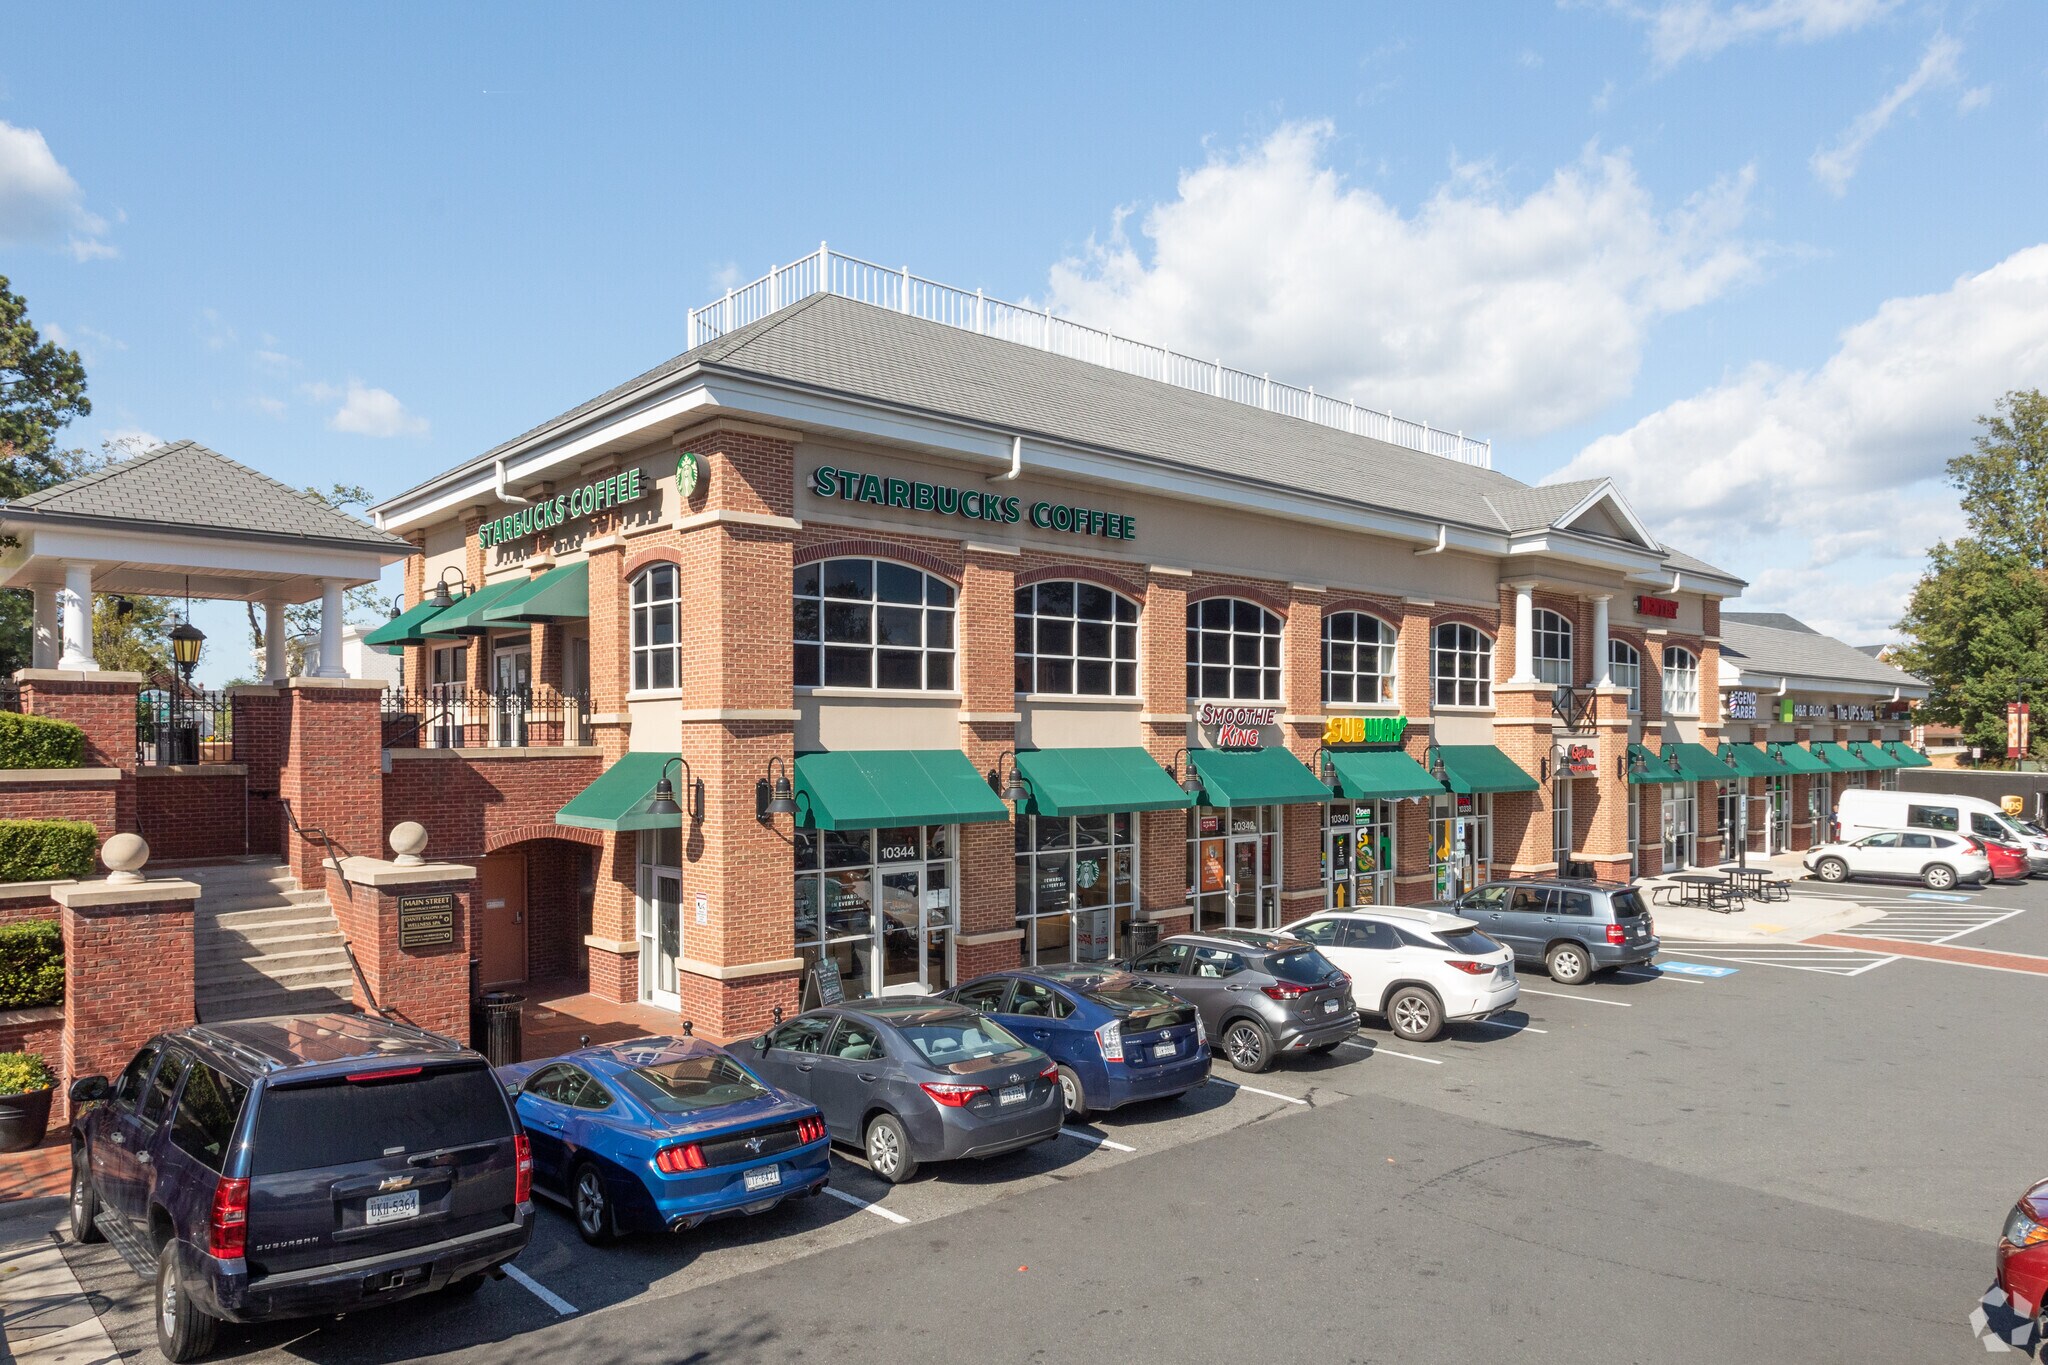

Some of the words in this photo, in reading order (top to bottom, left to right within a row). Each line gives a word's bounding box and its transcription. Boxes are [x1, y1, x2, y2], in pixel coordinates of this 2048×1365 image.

[479, 494, 565, 550] STARBUCKS
[570, 467, 641, 518] COFFEE
[815, 465, 1021, 524] STARBUCKS
[1033, 501, 1136, 541] COFFEE
[1201, 703, 1276, 725] SMOOTHIE
[1794, 704, 1807, 717] H&R
[1809, 705, 1827, 717] BLOCK
[1836, 704, 1848, 720] The
[1848, 705, 1860, 721] UPS
[1860, 706, 1875, 722] Store
[1326, 716, 1408, 743] SUBWAY
[1355, 806, 1371, 816] Open
[2004, 801, 2021, 812] ups
[1233, 820, 1255, 831] 10342
[1331, 814, 1349, 824] 10340
[881, 846, 915, 859] 10344
[425, 897, 450, 905] STREET
[371, 1197, 416, 1217] UKH-5364
[256, 1236, 319, 1251] SUBURBAN
